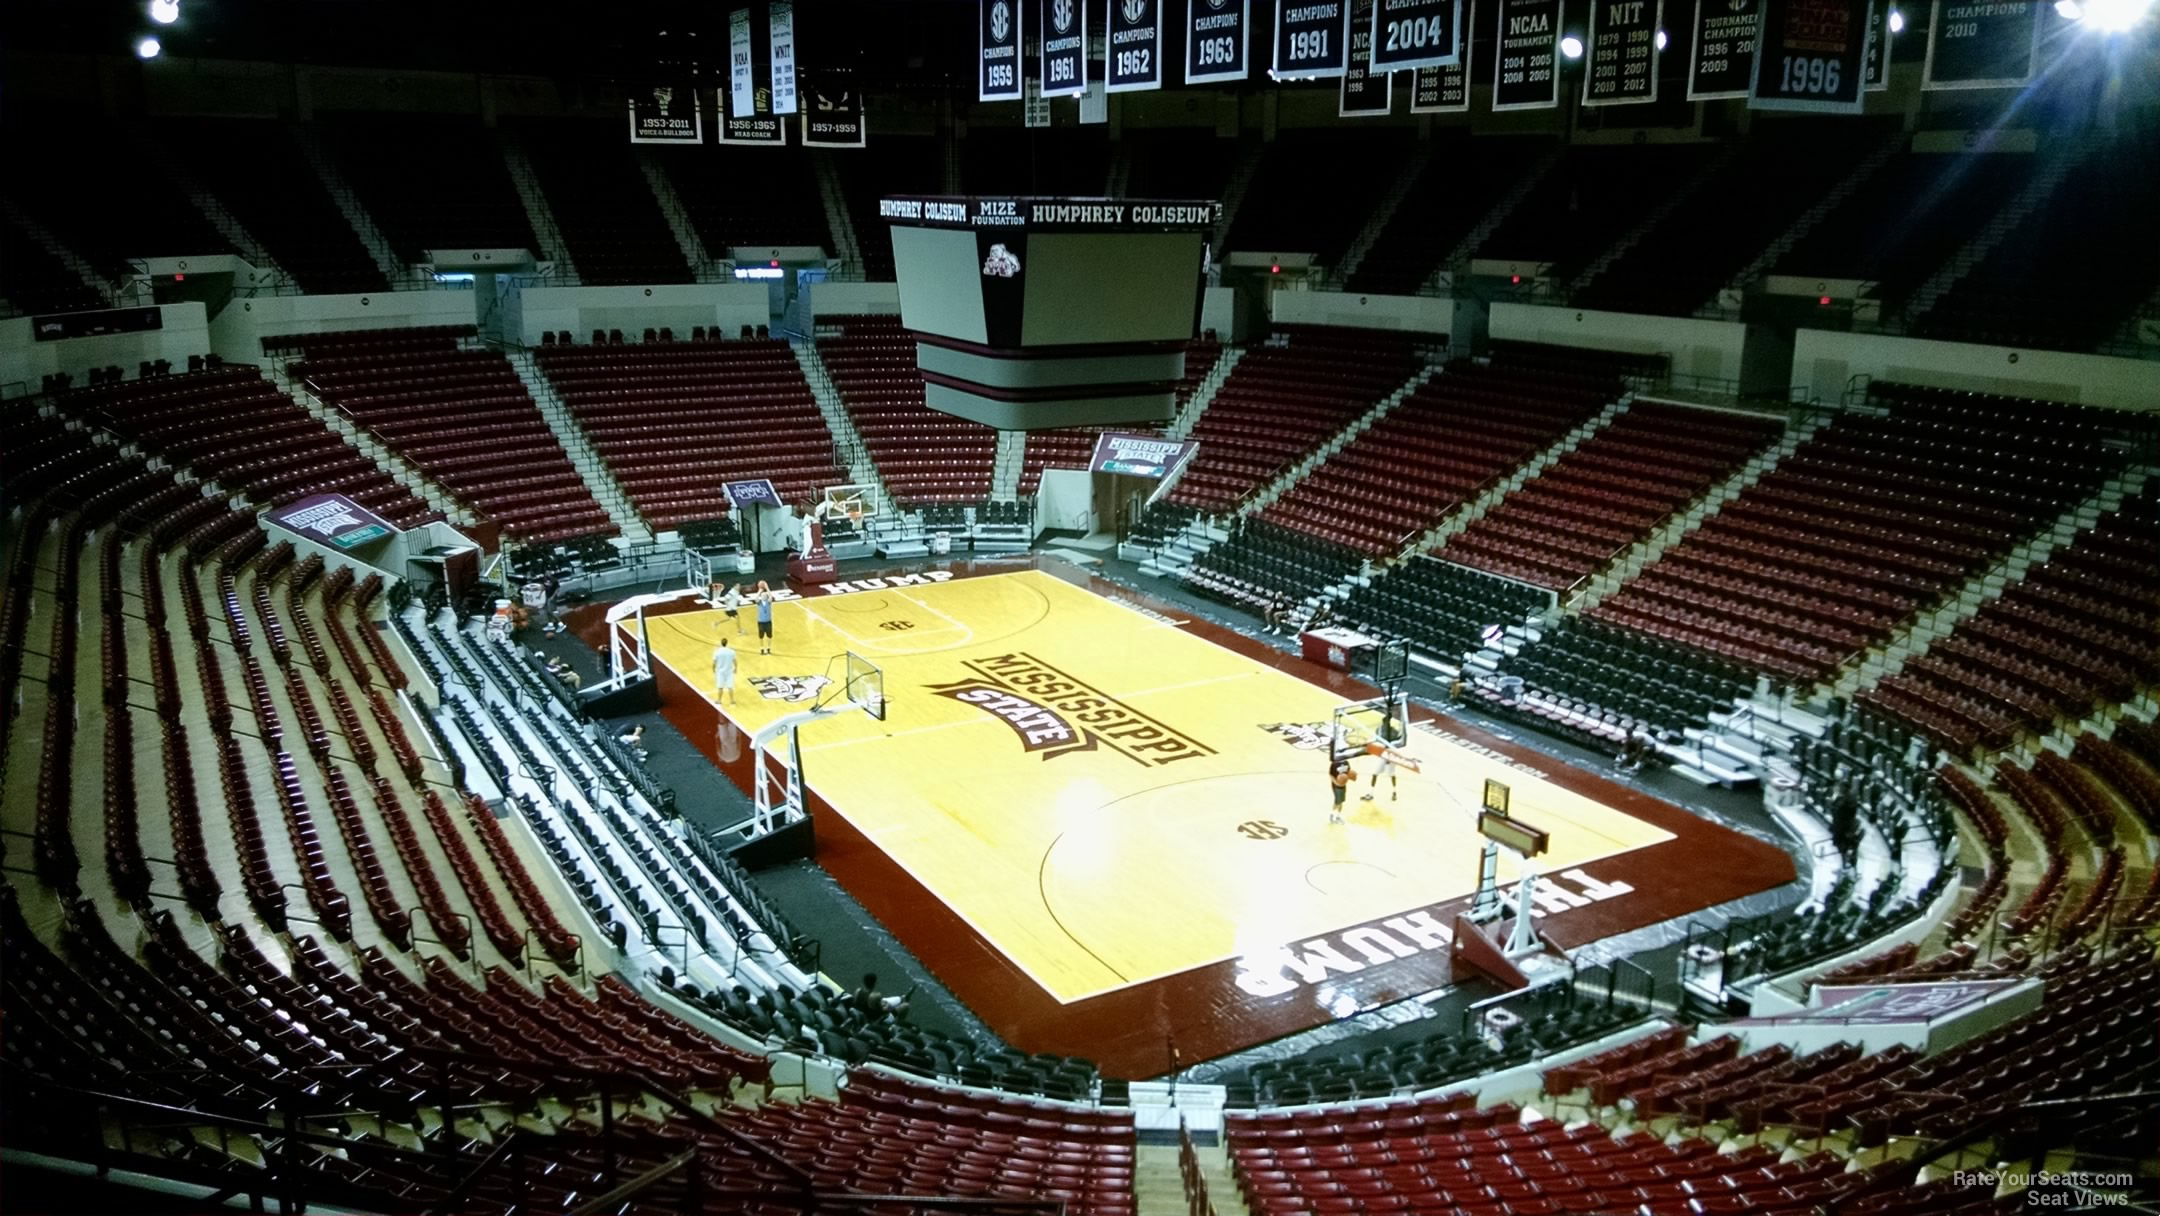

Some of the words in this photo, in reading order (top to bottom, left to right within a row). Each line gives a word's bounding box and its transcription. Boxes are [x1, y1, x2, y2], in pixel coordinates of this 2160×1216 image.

[1286, 3, 1338, 23] CHAMPIONS
[1609, 1, 1644, 26] NIT
[1947, 3, 2027, 19] CHAMPIONS
[991, 3, 1009, 42] SEC
[1195, 12, 1238, 31] CHAMPIONS
[1510, 13, 1548, 35] NCAA
[1945, 22, 1978, 38] 2010
[1113, 27, 1155, 44] CHAMPIONS
[1386, 15, 1441, 51] 2004
[1504, 34, 1554, 48] TOURNAMENT
[1598, 33, 1619, 46] 1979
[984, 46, 1014, 59] CHAMPIONS
[1046, 36, 1081, 52] CHAMPIONS
[1198, 37, 1234, 65] 1963
[1289, 30, 1328, 60] 1991
[1597, 49, 1618, 61] 1994
[1626, 46, 1648, 59] 1999
[1050, 57, 1074, 82] 1961
[1117, 49, 1150, 76] 1962
[1504, 57, 1524, 69] 2004
[1530, 54, 1551, 67] 2005
[1595, 65, 1617, 78] 2001
[1624, 62, 1647, 75] 2007
[988, 64, 1013, 87] 1959
[1529, 69, 1550, 82] 2009
[1780, 56, 1841, 94] 1996
[1594, 81, 1616, 93] 2010
[1624, 78, 1645, 91] 2012
[1419, 91, 1438, 102] 2002
[1443, 90, 1461, 101] 2003
[880, 200, 922, 219] HUMPHREY
[925, 203, 967, 222] COLISEUM
[980, 202, 1017, 216] MIZE
[1032, 205, 1125, 224] HUMPHREY
[1132, 206, 1210, 224] COLISEUM
[971, 215, 1026, 226] FOUNDATION
[819, 570, 954, 595] HUMP
[956, 688, 1070, 745] STATE
[973, 653, 1207, 765] MISSISSIPPI
[1237, 820, 1289, 840] SEC
[1235, 910, 1454, 997] HUMP
